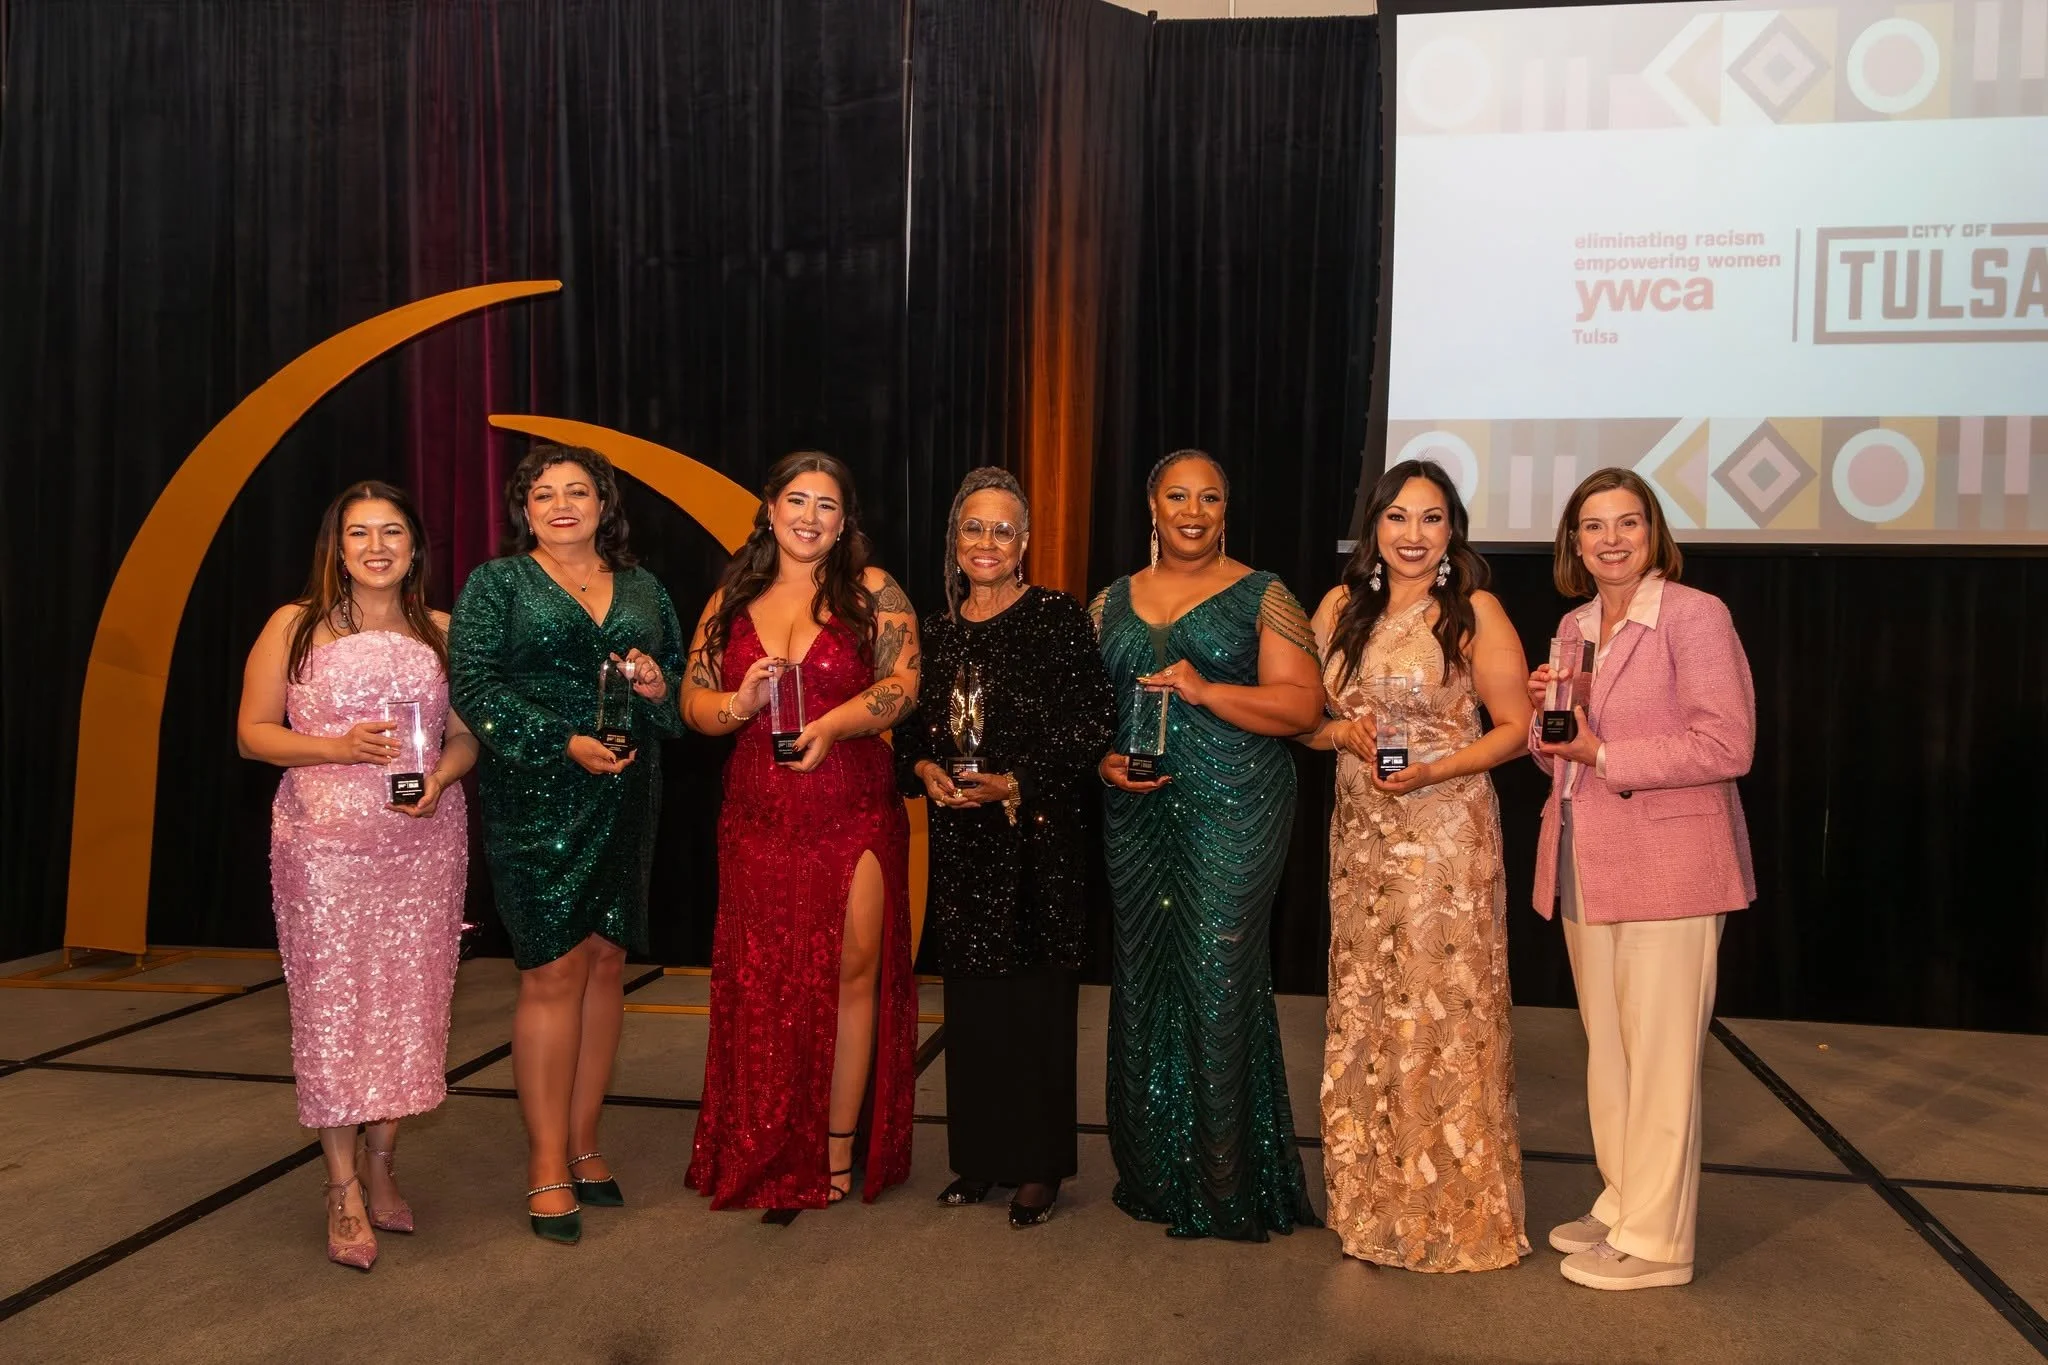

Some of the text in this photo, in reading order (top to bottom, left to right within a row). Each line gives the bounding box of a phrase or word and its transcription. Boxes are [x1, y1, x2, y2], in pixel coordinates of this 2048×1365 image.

[1574, 230, 1766, 250] eliminating racism
[1911, 223, 1987, 239] CITY OF
[1573, 253, 1782, 273] empowering women
[1839, 246, 2048, 320] TULSA
[1574, 276, 1715, 323] ywca
[1571, 328, 1619, 345] Tulsa
